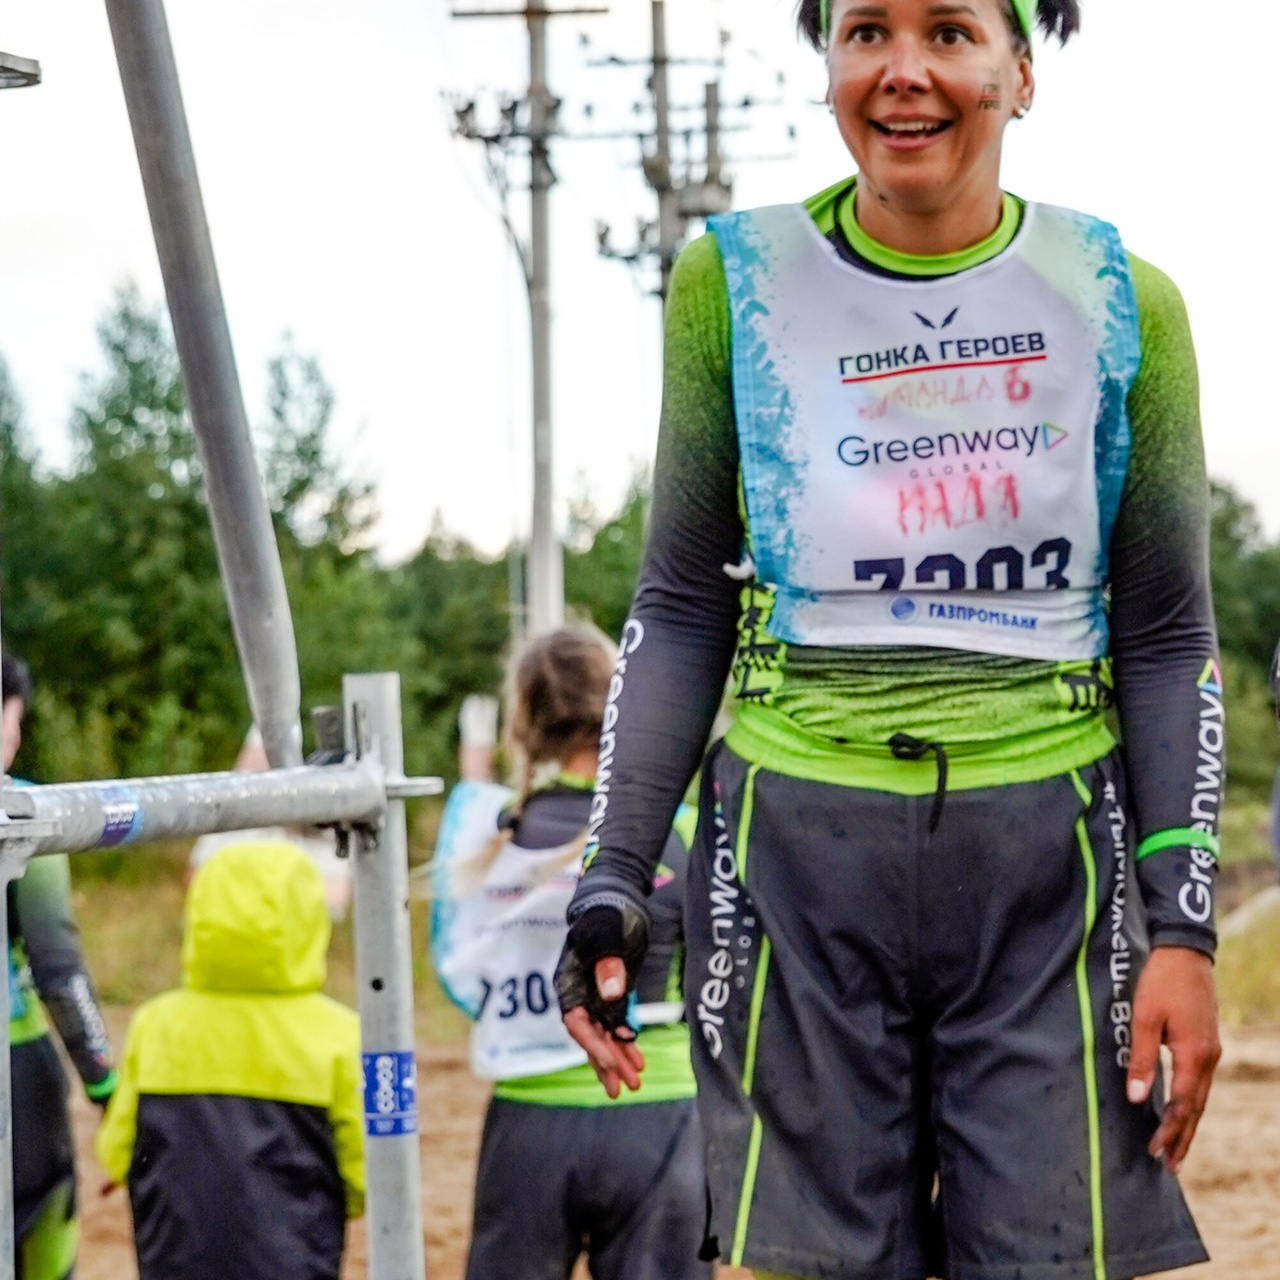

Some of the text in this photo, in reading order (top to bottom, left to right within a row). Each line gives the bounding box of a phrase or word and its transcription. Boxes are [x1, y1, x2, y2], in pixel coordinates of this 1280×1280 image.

[839, 332, 1046, 376] ГОНКА ГЕРОЕВ
[837, 423, 1041, 468] Greenway
[909, 462, 1005, 480] GLOBAL
[929, 603, 1037, 630] ГАЗПРОМБАНК
[475, 971, 551, 1021] 730
